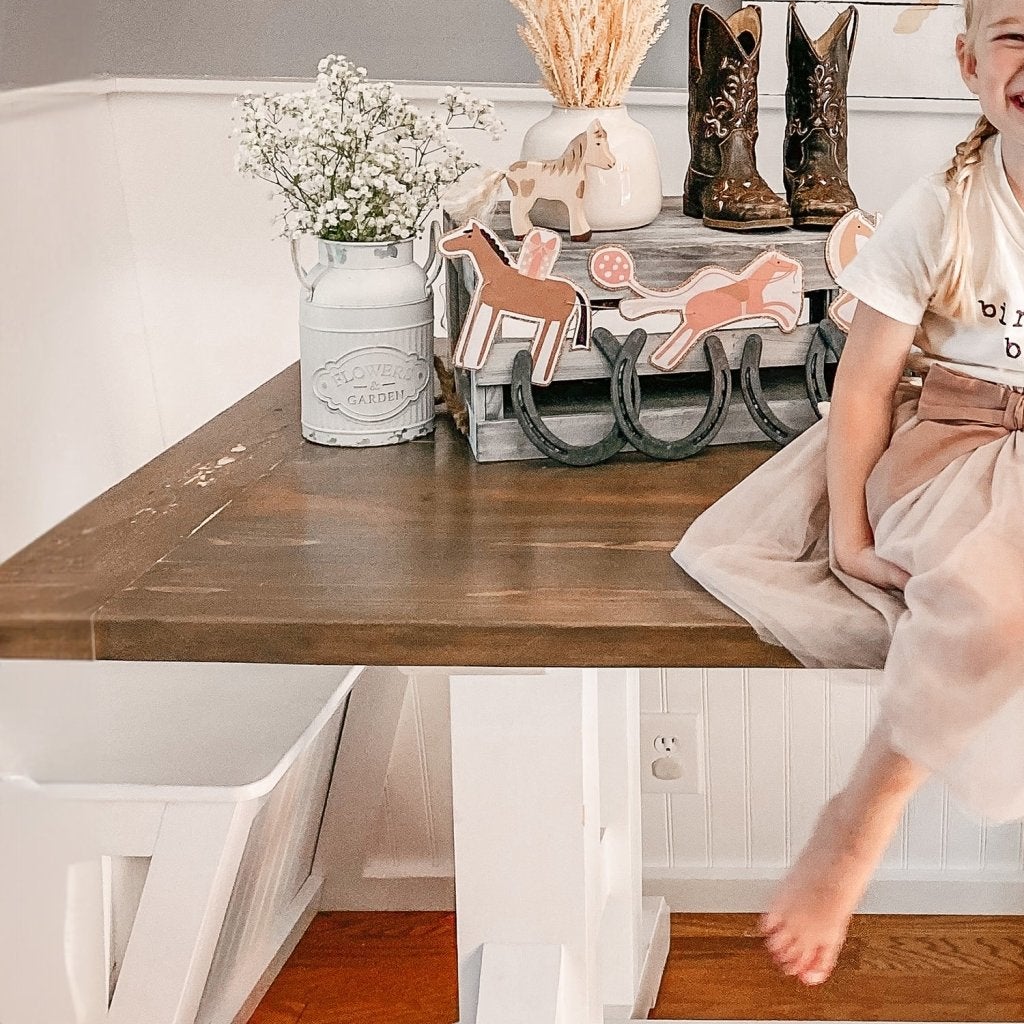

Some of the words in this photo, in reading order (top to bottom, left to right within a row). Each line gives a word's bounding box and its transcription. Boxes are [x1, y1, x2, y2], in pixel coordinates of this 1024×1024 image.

[334, 364, 414, 387] FLOWERS
[369, 381, 380, 391] &
[347, 389, 404, 405] GARDEN
